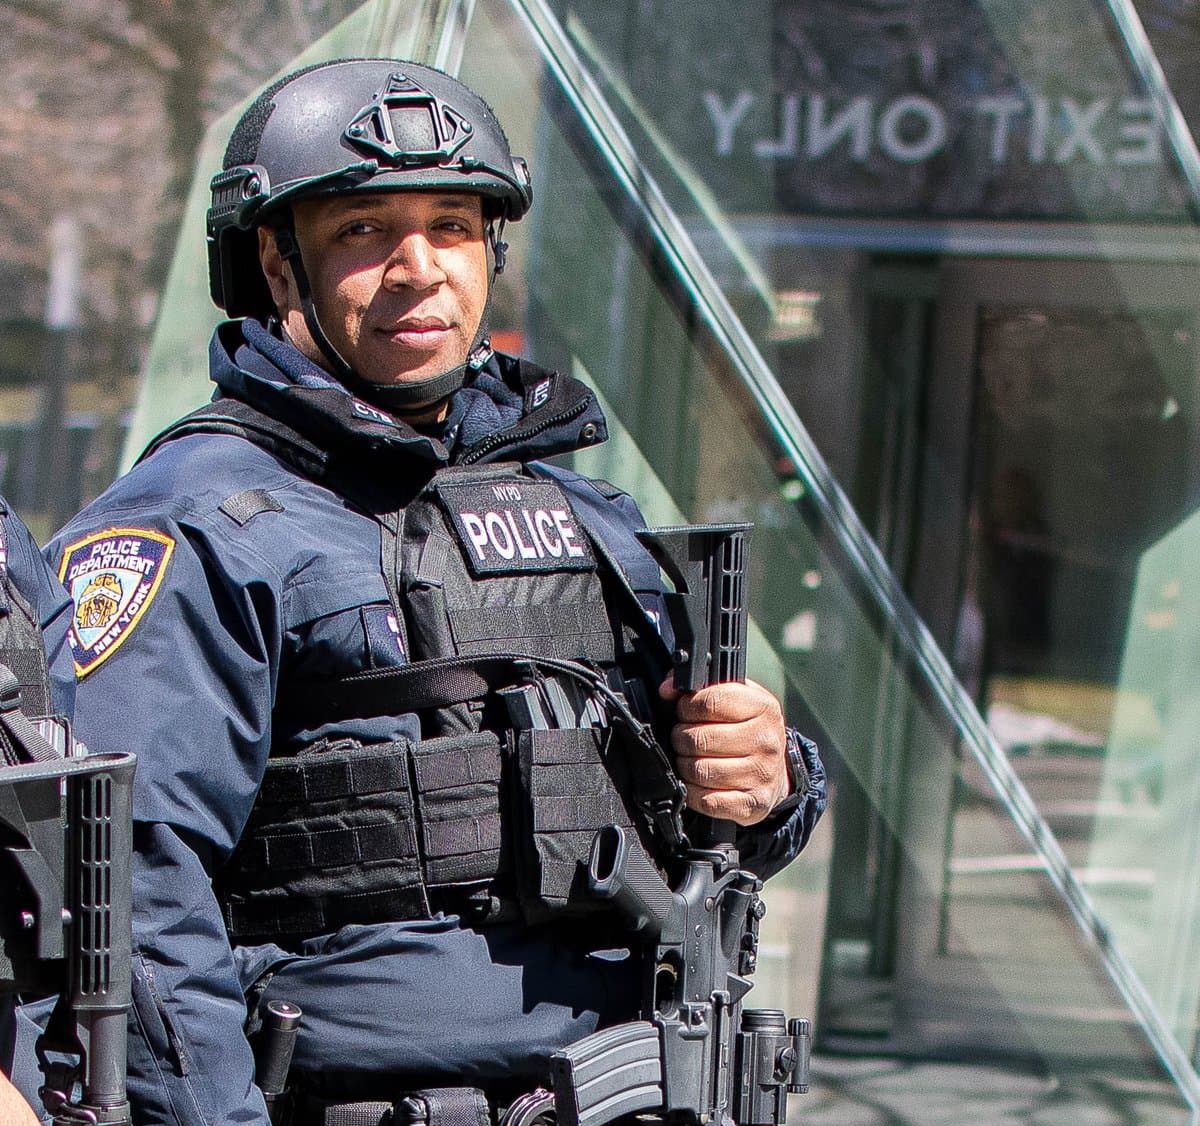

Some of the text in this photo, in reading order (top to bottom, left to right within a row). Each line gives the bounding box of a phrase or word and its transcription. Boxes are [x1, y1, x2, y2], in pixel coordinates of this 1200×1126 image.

[492, 486, 521, 501] NYPD
[460, 508, 584, 560] POLICE
[90, 540, 141, 559] POLICE
[68, 556, 155, 580] DEPARTMENT
[93, 583, 151, 655] NEW YORK
